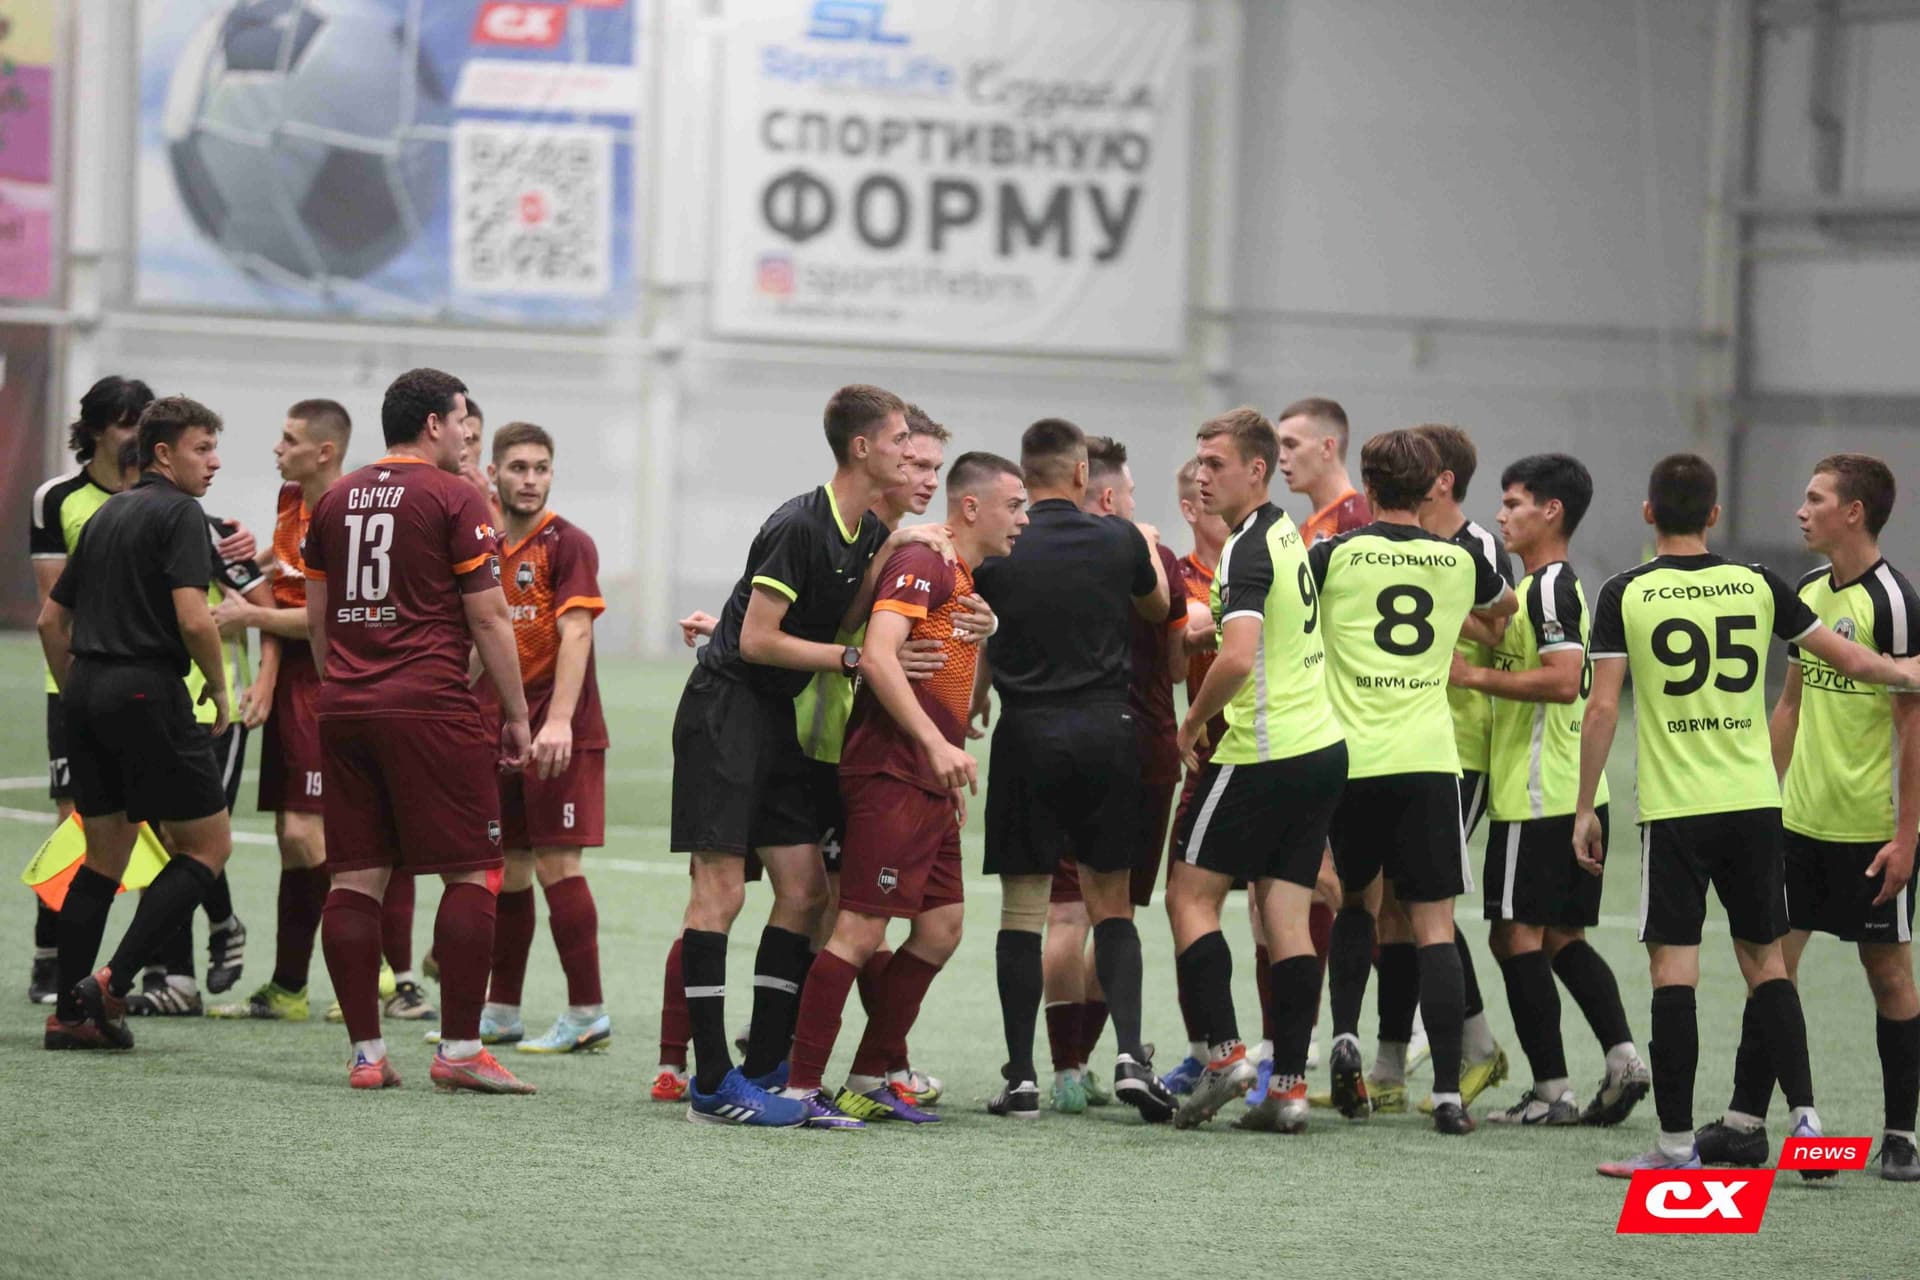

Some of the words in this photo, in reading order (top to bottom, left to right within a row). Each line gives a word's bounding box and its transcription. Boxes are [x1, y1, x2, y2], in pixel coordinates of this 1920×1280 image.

[760, 109, 1150, 173] СПОРТИВНУЮ
[760, 167, 1143, 262] ФОРМУ
[348, 486, 405, 510] СЫЧЕВ
[345, 513, 395, 601] 13
[337, 606, 397, 623] SEUS
[1298, 561, 1318, 634] 9
[1373, 584, 1435, 656] 8
[1375, 676, 1405, 689] RVM
[1651, 615, 1759, 697] 95
[1689, 717, 1719, 732] RVM
[305, 771, 322, 796] 19
